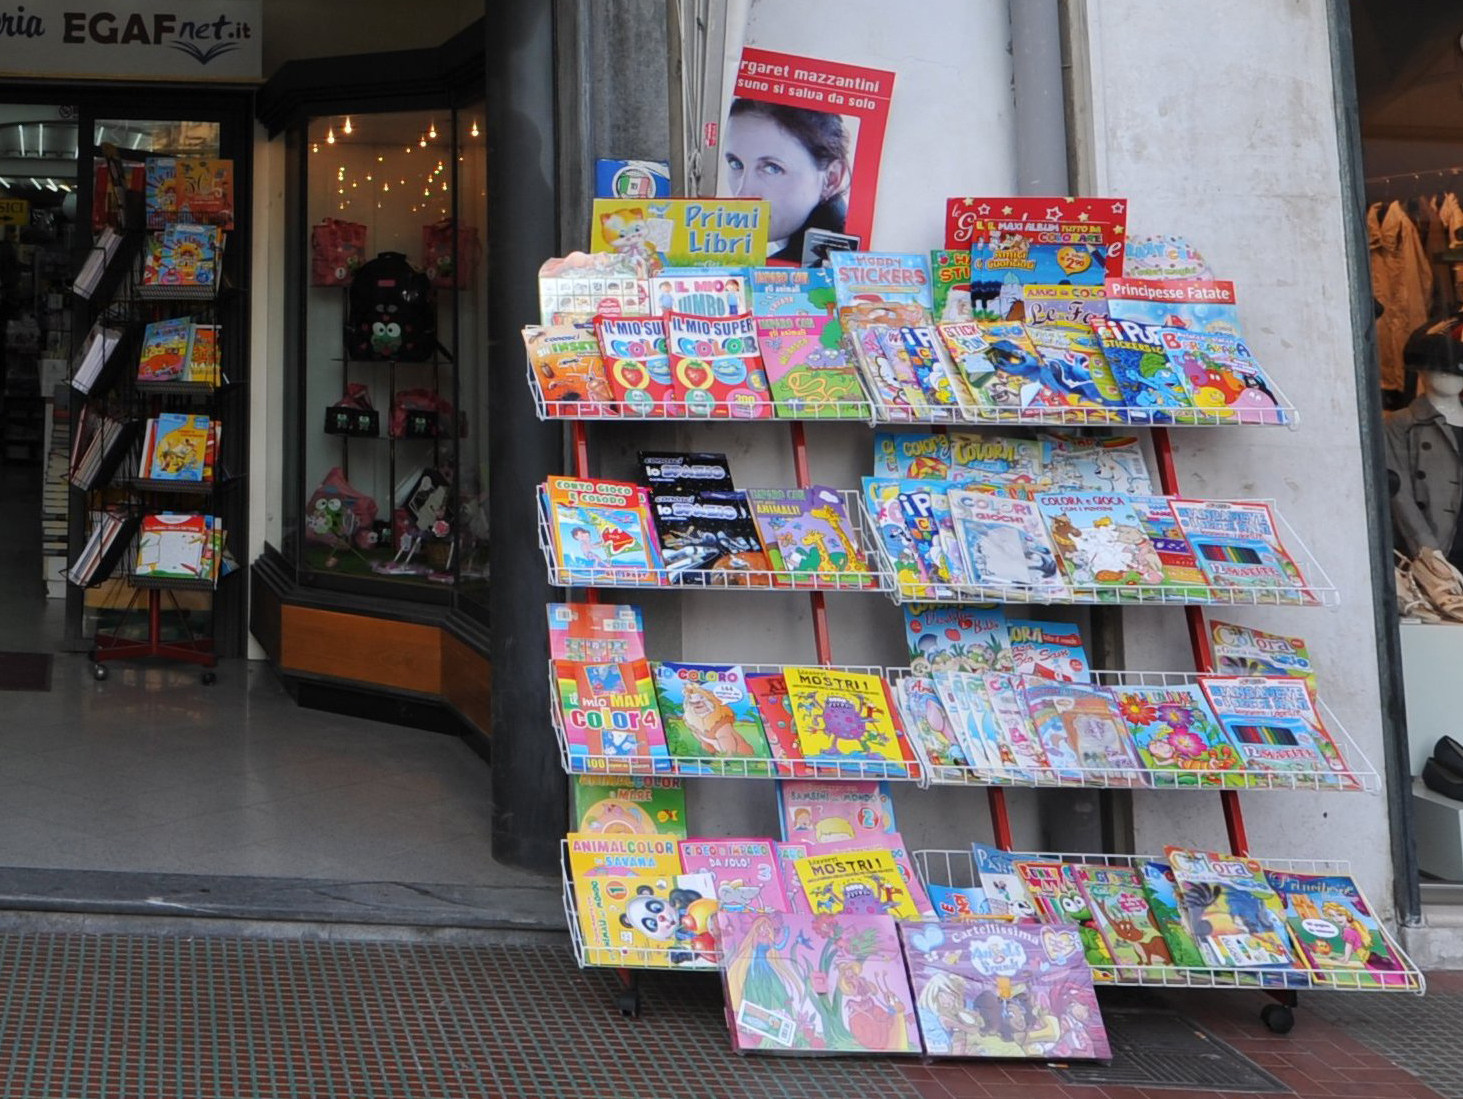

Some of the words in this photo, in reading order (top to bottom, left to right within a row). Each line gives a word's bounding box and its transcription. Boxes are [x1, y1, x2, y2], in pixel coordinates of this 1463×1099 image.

[740, 59, 790, 78] rgaret
[794, 68, 880, 93] mazzantini
[737, 76, 769, 92] suno
[773, 82, 785, 94] si
[788, 86, 824, 102] salva
[828, 92, 844, 105] da
[848, 96, 877, 111] solo
[685, 205, 760, 230] Primi
[998, 221, 1023, 232] MAXI
[1024, 221, 1060, 232] ALBUM
[1061, 223, 1089, 232] TUTTO
[689, 230, 752, 255] Libri
[1038, 232, 1104, 244] COLORARE
[838, 266, 928, 285] STICKERS
[674, 280, 690, 294] IL
[694, 279, 725, 293] MIO
[1071, 288, 1107, 298] COLO
[1111, 282, 1184, 300] Principesse
[1187, 286, 1231, 300] Fatate
[604, 320, 615, 334] IL
[618, 320, 642, 335] MIO
[672, 318, 684, 332] IL
[686, 318, 712, 335] MIO
[714, 317, 754, 336] SUPER
[943, 323, 979, 339] STICK
[552, 341, 599, 354] INSET
[610, 337, 668, 358] COLO
[677, 335, 758, 358] COLOR
[646, 465, 661, 477] lo
[662, 465, 727, 480] SPAZIO
[596, 483, 632, 496] GIOCO
[1041, 496, 1083, 506] COLORA
[1091, 496, 1125, 507] GIOCA
[656, 503, 672, 516] lo
[672, 504, 738, 520] SPAZIO
[1210, 563, 1226, 574] 12
[1226, 565, 1282, 578] MATITE
[678, 668, 739, 683] COLORO
[582, 695, 607, 707] mio
[610, 693, 651, 708] MAXI
[571, 708, 641, 730] color
[642, 710, 658, 729] 4
[1244, 746, 1261, 758] 12
[1260, 747, 1316, 760] MATITE
[586, 757, 606, 769] 100
[617, 788, 653, 802] MARE
[861, 808, 875, 828] 2
[572, 840, 675, 854] ANIMALCOLOR
[684, 845, 718, 857] GIOCO
[604, 856, 657, 868] SAVANA
[708, 857, 722, 868] DA
[723, 856, 753, 868] SOLO!
[756, 863, 772, 881] 3
[951, 923, 1040, 946] Cartellissima
